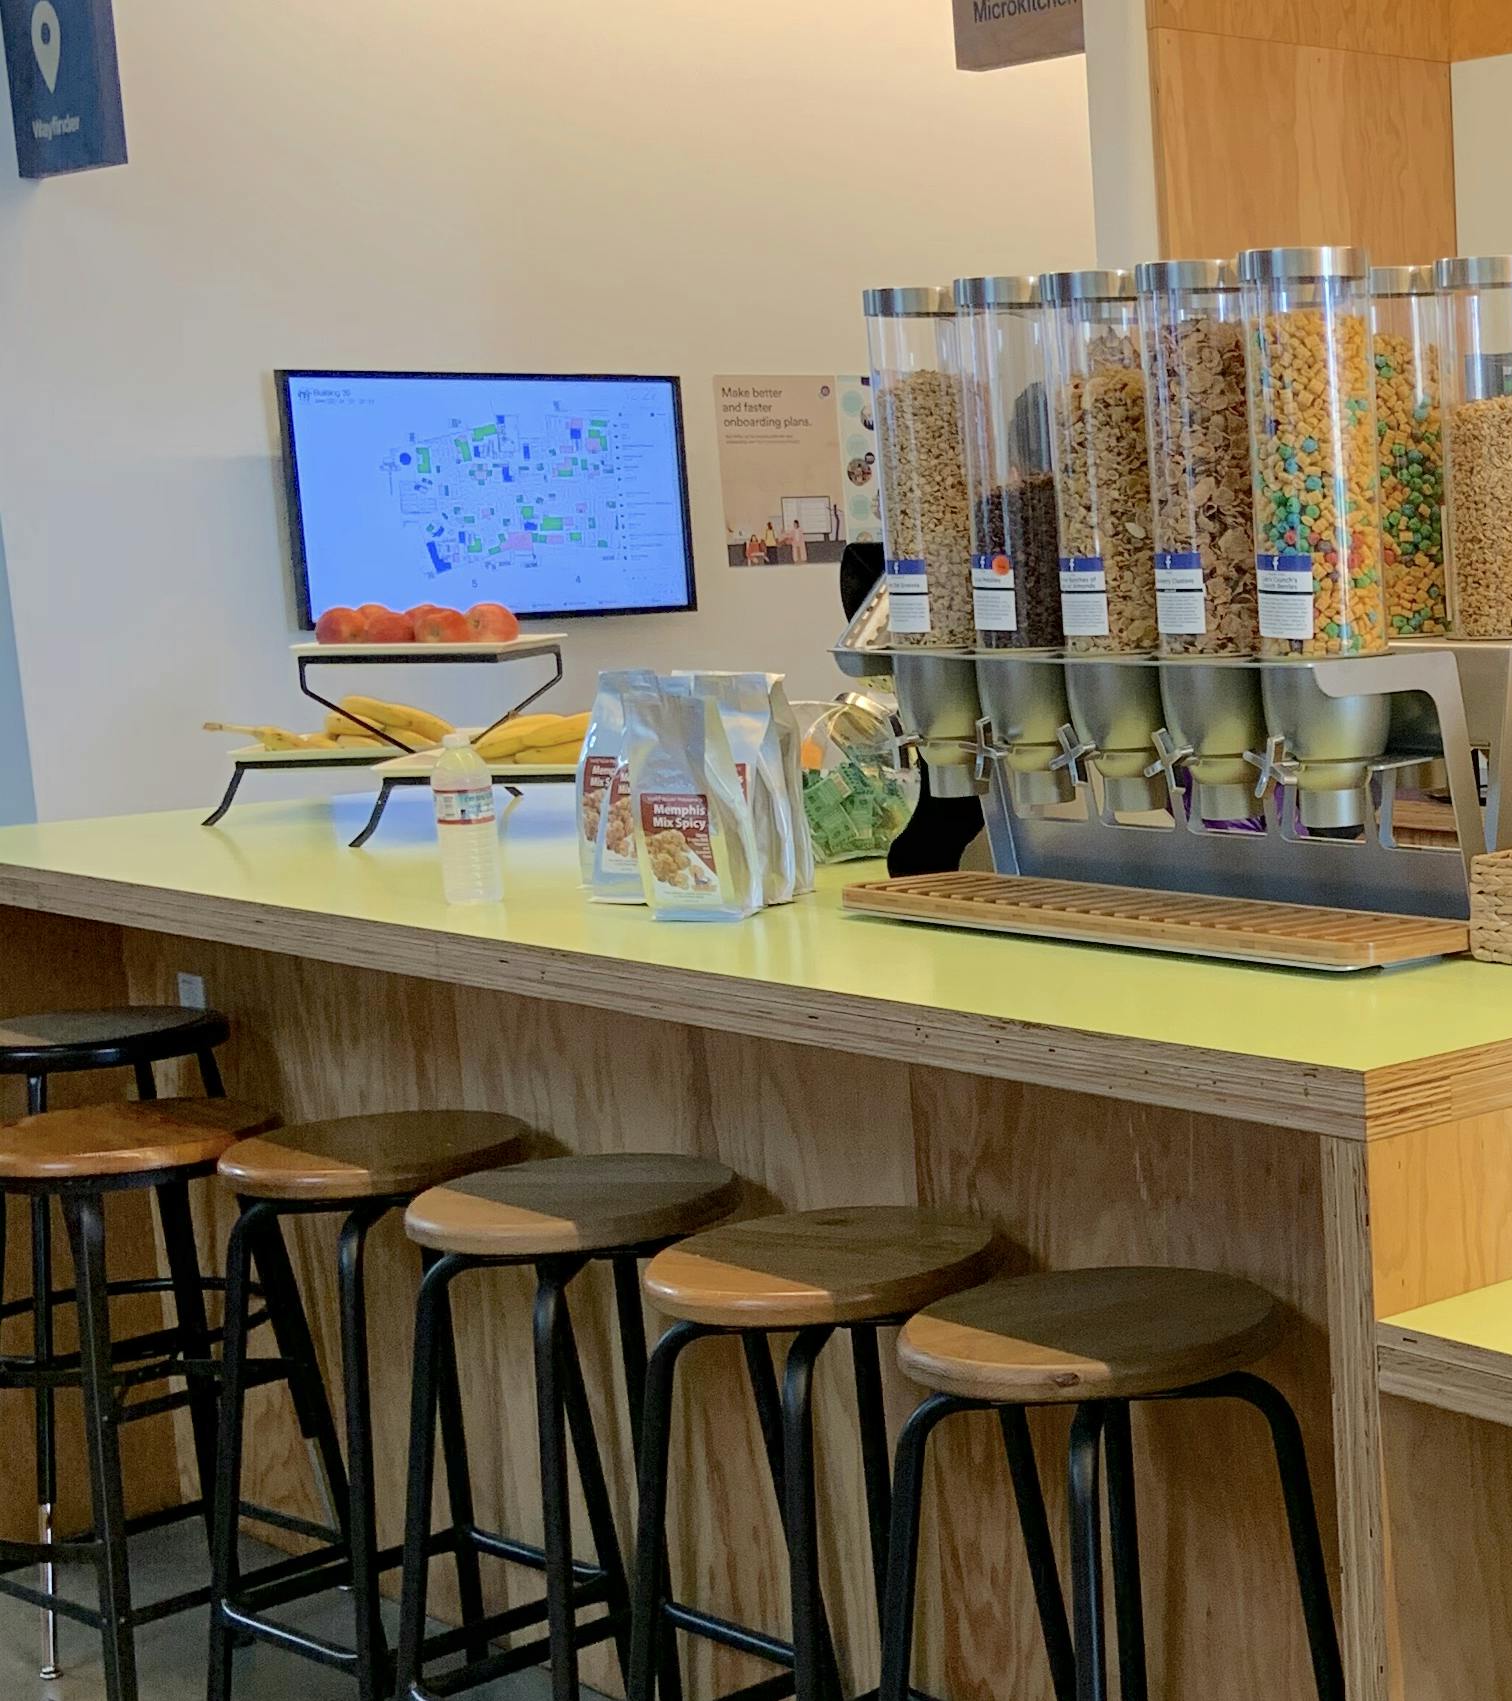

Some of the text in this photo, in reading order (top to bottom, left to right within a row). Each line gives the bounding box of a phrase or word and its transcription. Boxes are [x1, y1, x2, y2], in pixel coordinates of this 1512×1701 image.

[973, 0, 1077, 23] Microkitc
[31, 114, 80, 140] Wayfinder
[721, 387, 783, 398] Make better
[722, 403, 773, 413] and faster
[723, 417, 812, 429] onboarding plans.
[591, 764, 616, 776] Memp
[653, 804, 706, 817] Memphis
[653, 816, 706, 831] Mix Spicy
